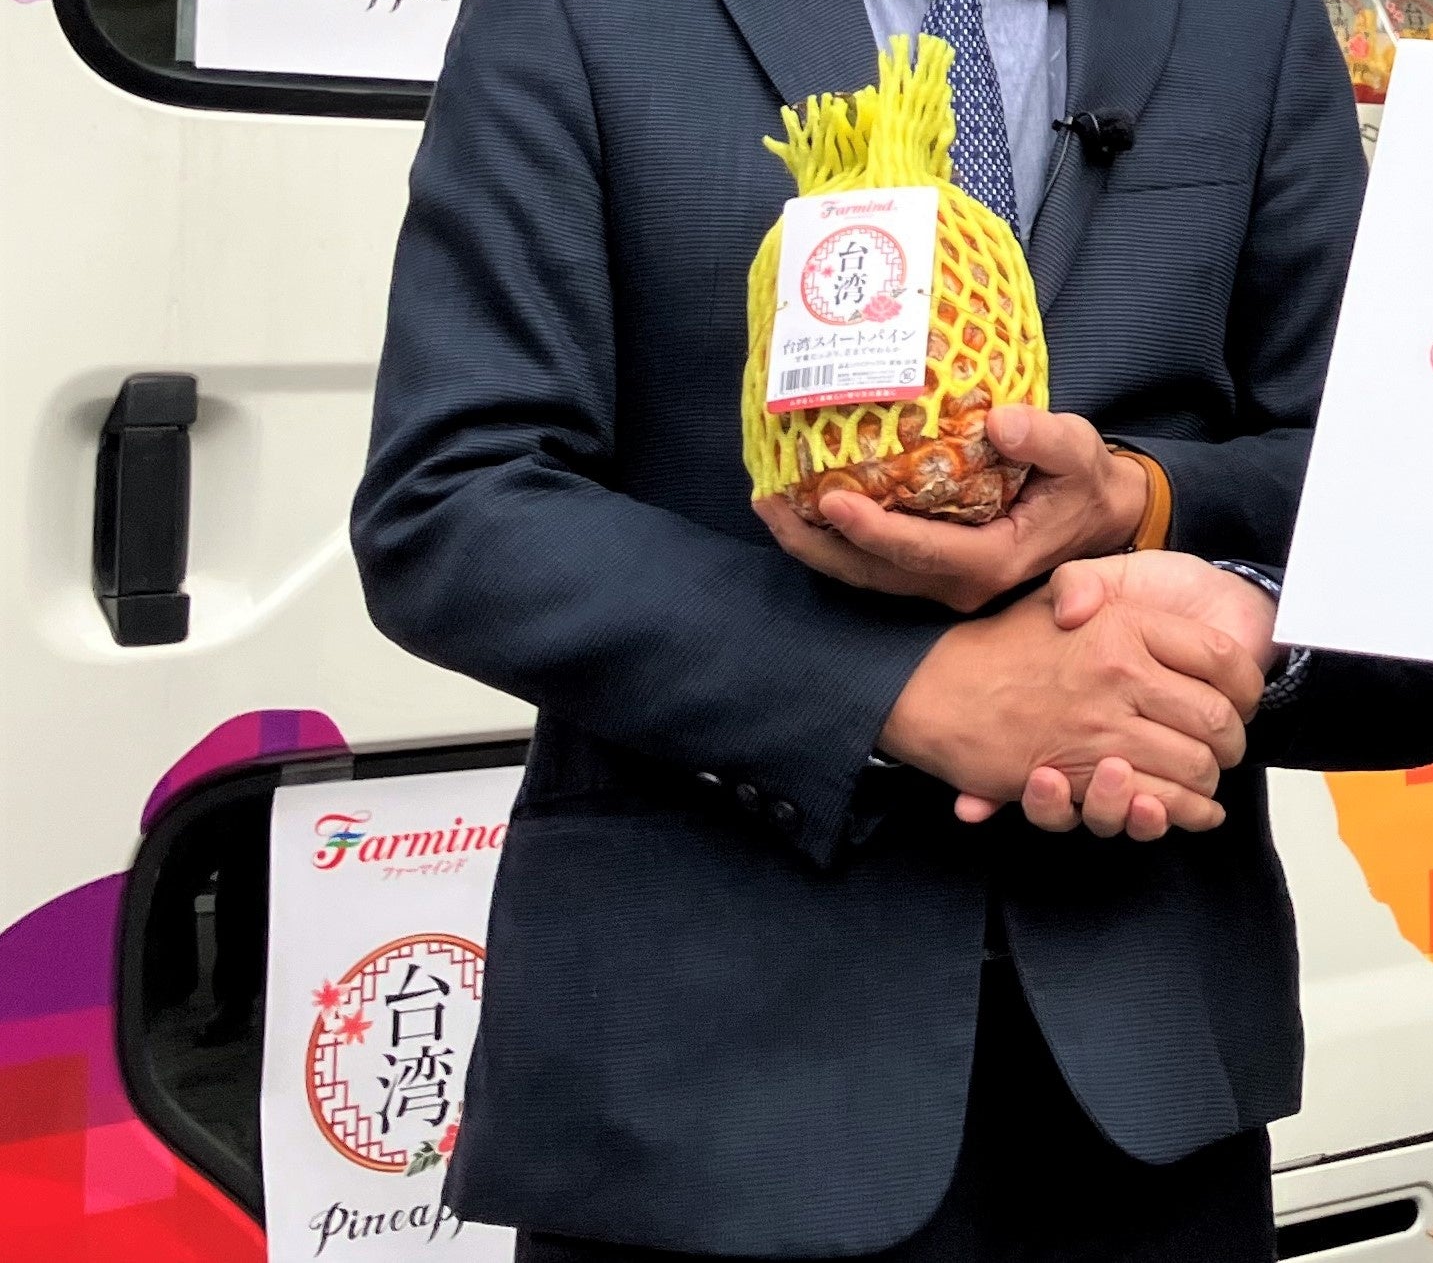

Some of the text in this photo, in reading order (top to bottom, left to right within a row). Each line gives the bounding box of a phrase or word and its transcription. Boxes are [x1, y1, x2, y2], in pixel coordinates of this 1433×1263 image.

[834, 241, 868, 306] 台湾
[783, 328, 916, 356] 台湾スイートパイン
[376, 962, 455, 1136] 台湾
